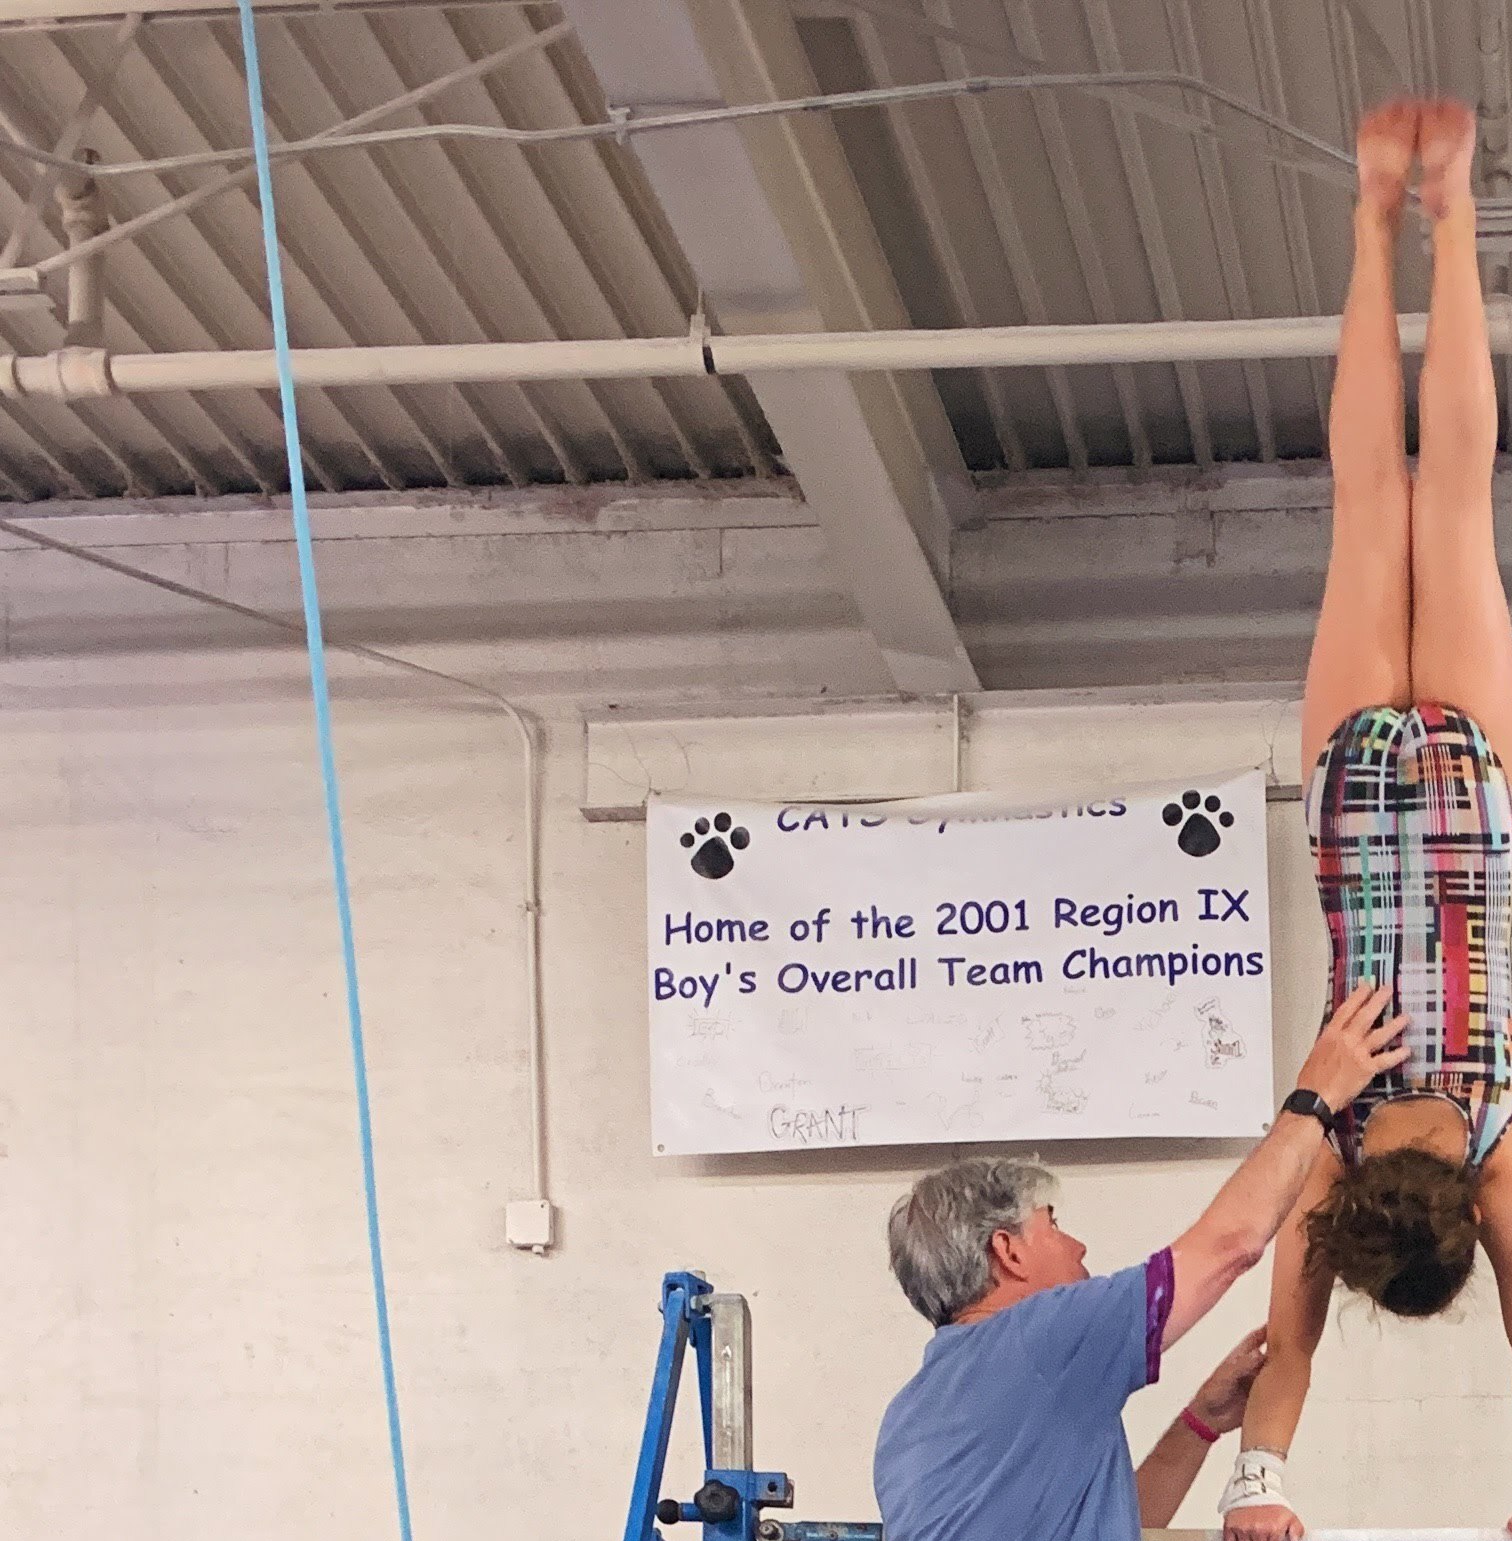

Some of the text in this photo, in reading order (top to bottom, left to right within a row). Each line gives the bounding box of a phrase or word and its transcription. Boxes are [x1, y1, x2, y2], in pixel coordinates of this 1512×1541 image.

[664, 888, 1251, 946] Home of the 2001 Region IX
[654, 943, 1265, 1009] Boy's Overall Team Champions
[769, 1104, 868, 1143] GRANT
